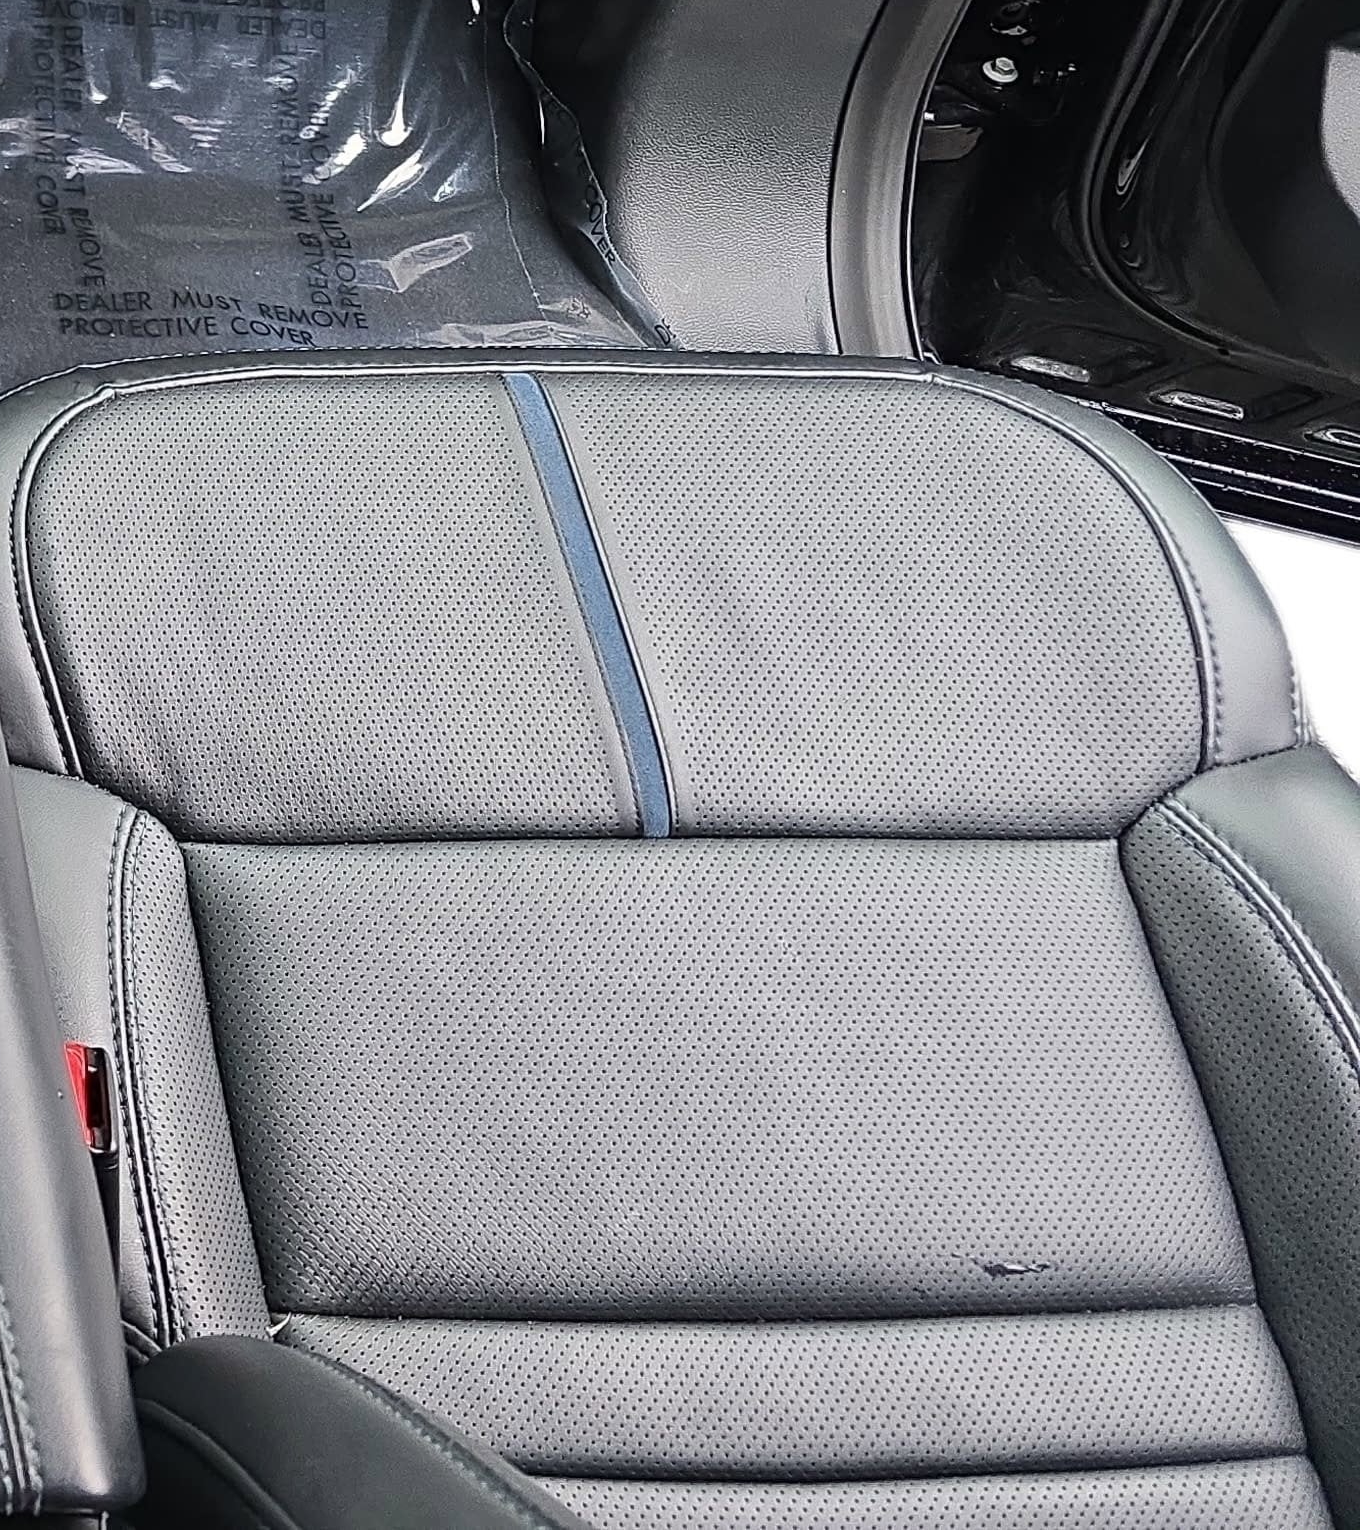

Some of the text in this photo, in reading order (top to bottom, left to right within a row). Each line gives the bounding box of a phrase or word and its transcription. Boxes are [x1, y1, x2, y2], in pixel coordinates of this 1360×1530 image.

[584, 184, 617, 265] COVER
[54, 290, 370, 330] DEALER MUST REMOVE
[58, 316, 318, 347] PROTECTIVE COVER
